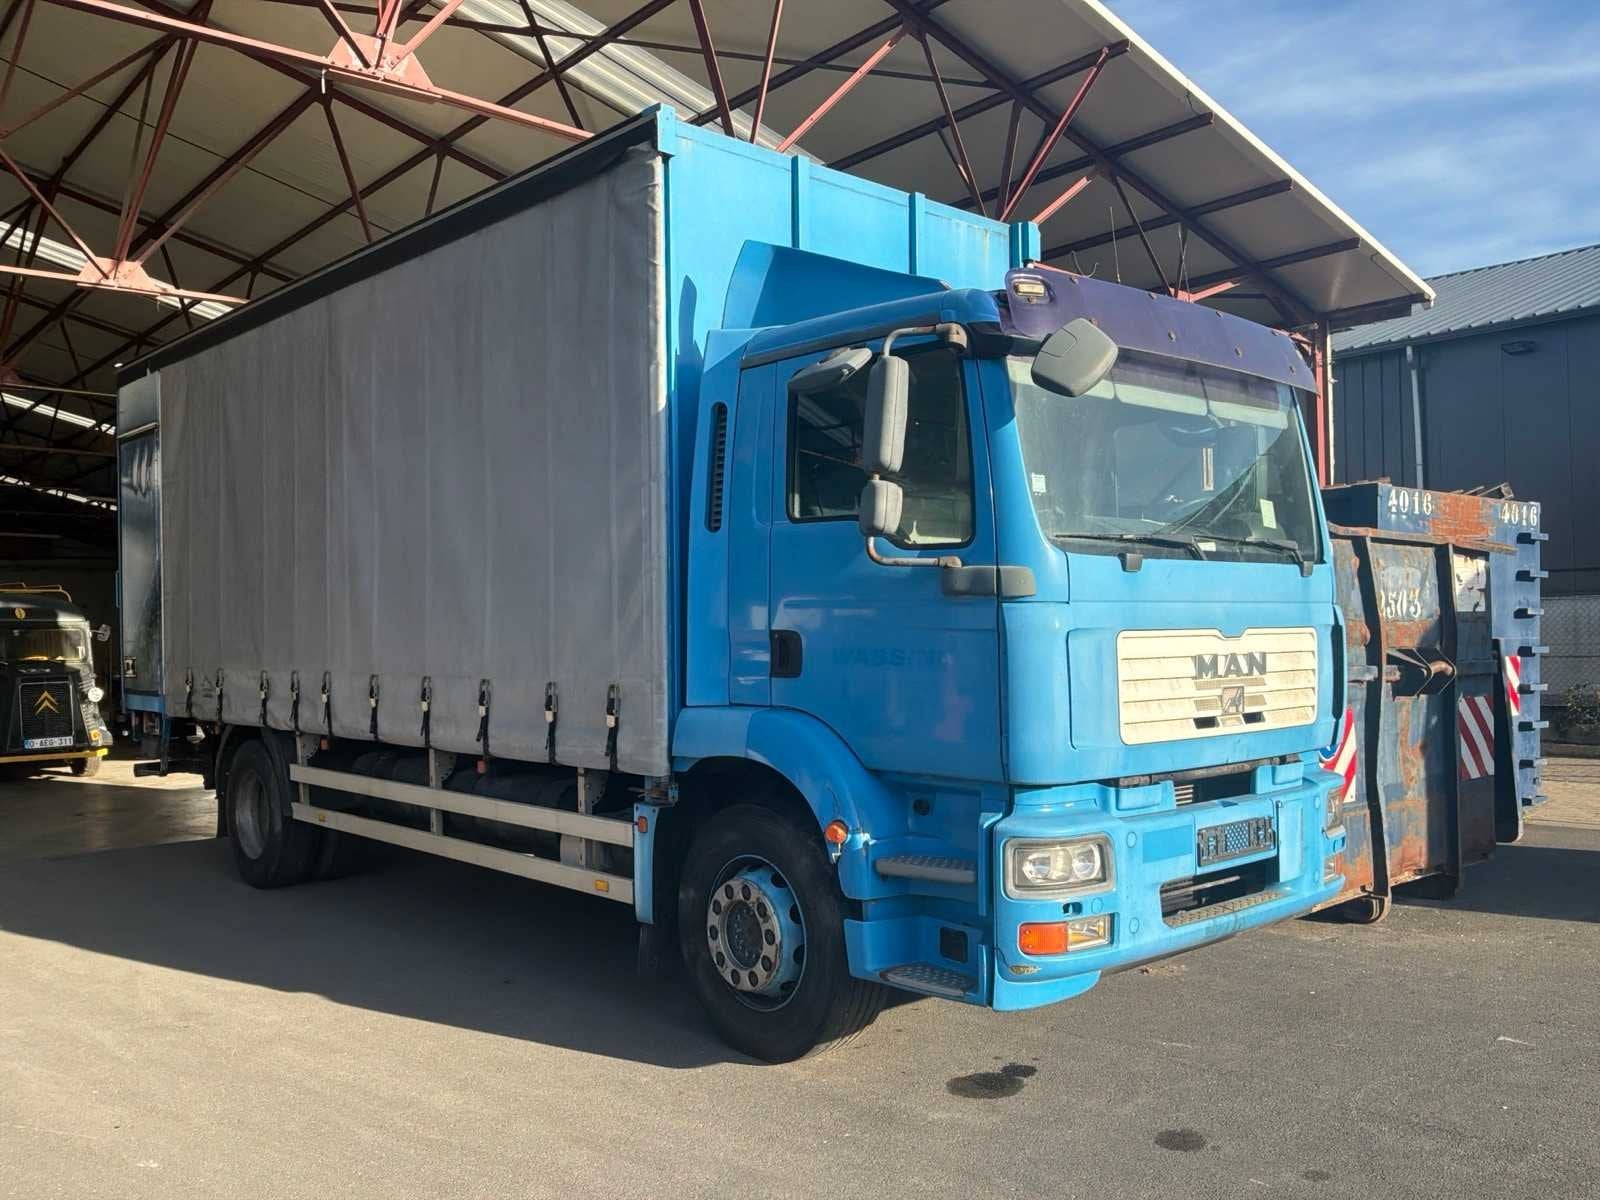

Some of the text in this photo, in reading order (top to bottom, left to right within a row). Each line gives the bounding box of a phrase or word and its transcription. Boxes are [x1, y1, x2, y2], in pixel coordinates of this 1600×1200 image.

[1388, 488, 1432, 516] 4016
[1501, 502, 1538, 527] 4016
[1196, 652, 1267, 680] MAN
